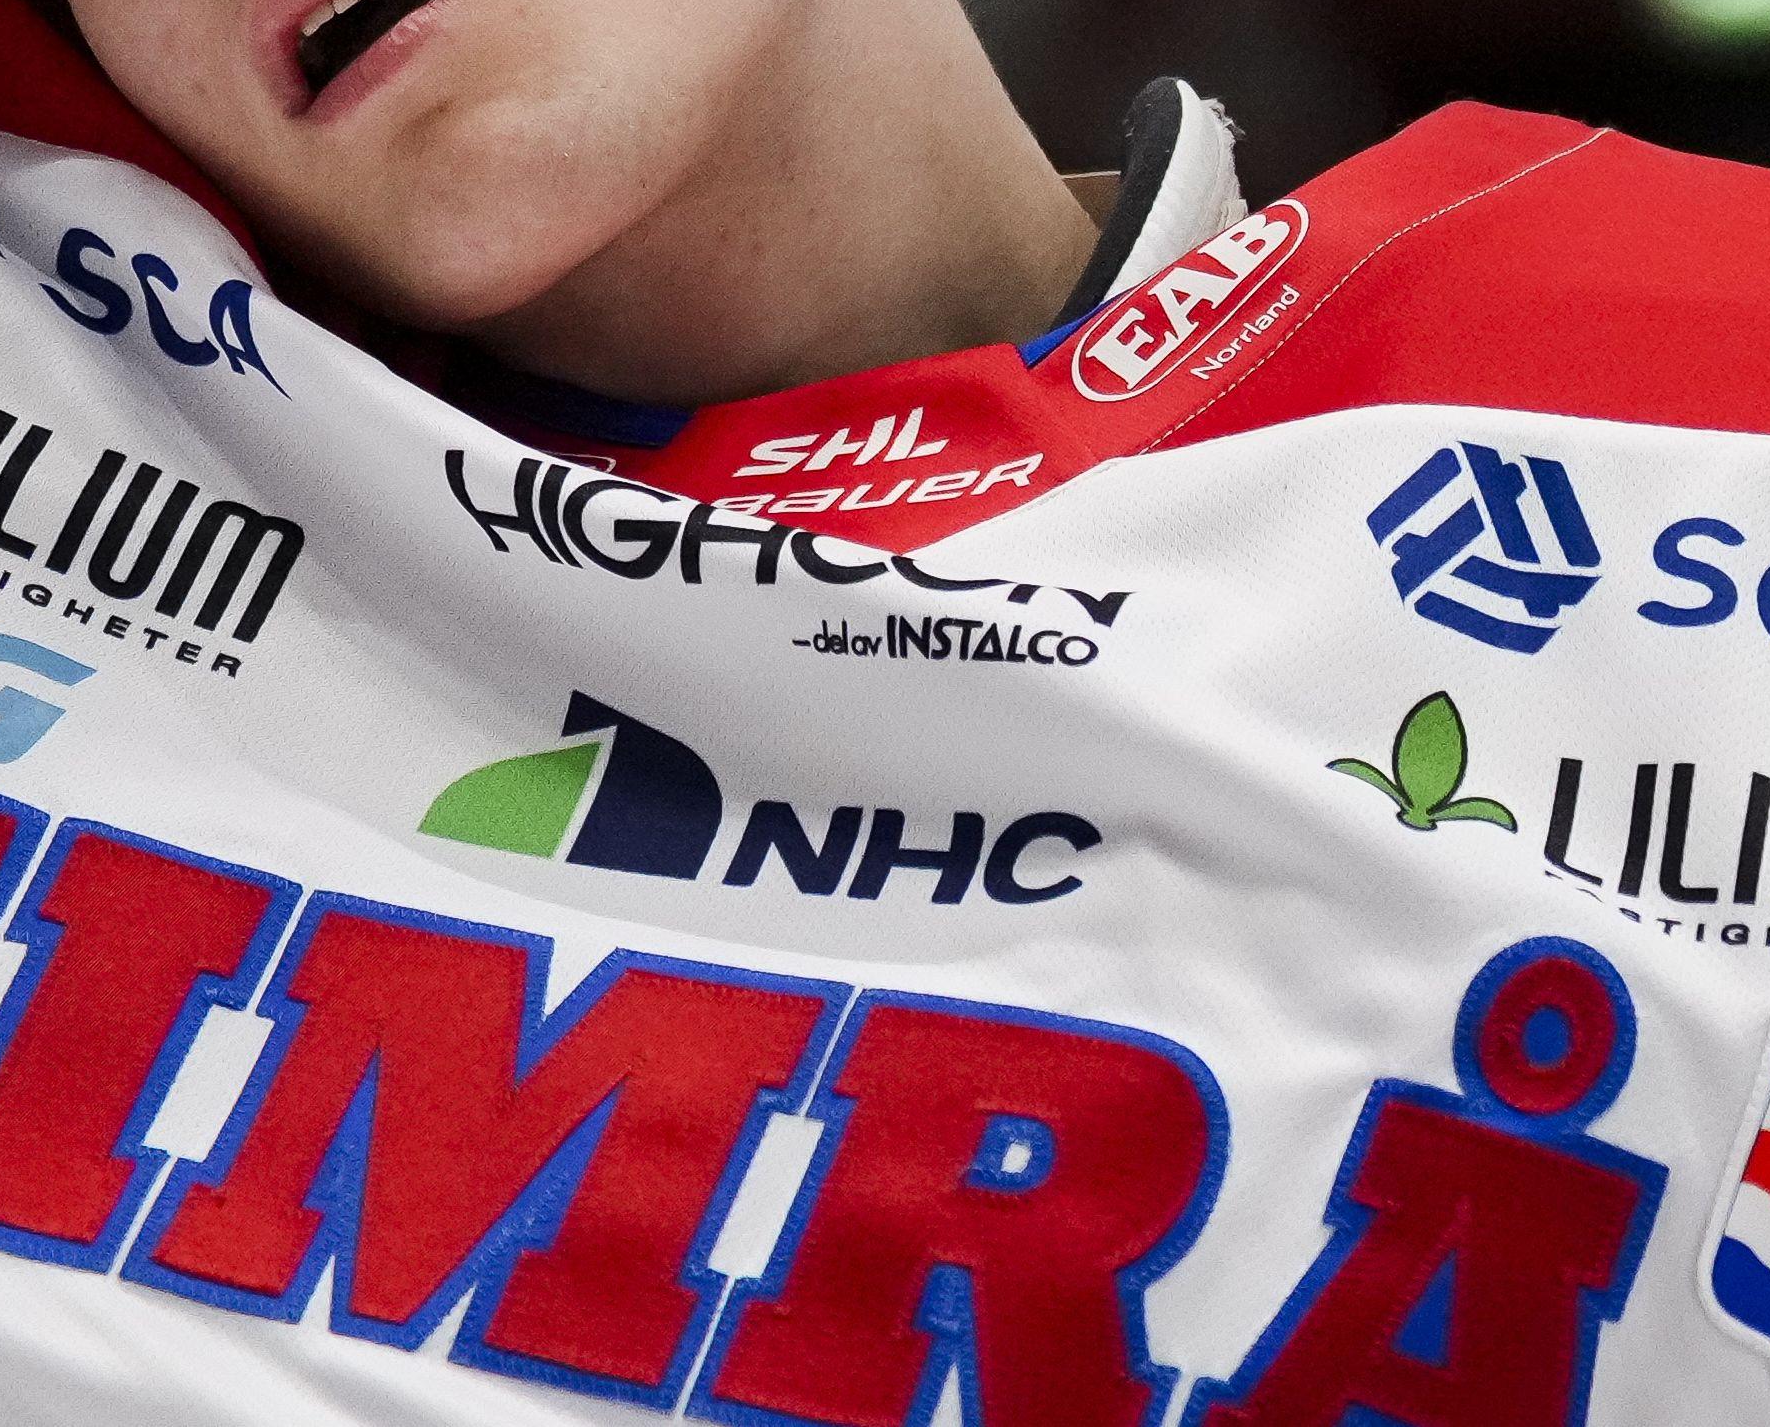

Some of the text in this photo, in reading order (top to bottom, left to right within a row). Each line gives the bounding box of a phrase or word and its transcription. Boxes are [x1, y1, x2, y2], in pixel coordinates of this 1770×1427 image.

[41, 227, 293, 401] SCA
[1086, 212, 1291, 390] EAB
[1190, 282, 1302, 380] Norrland
[731, 406, 950, 479] SHL
[886, 614, 1100, 667] INSTALCO
[722, 800, 1103, 906] NHC
